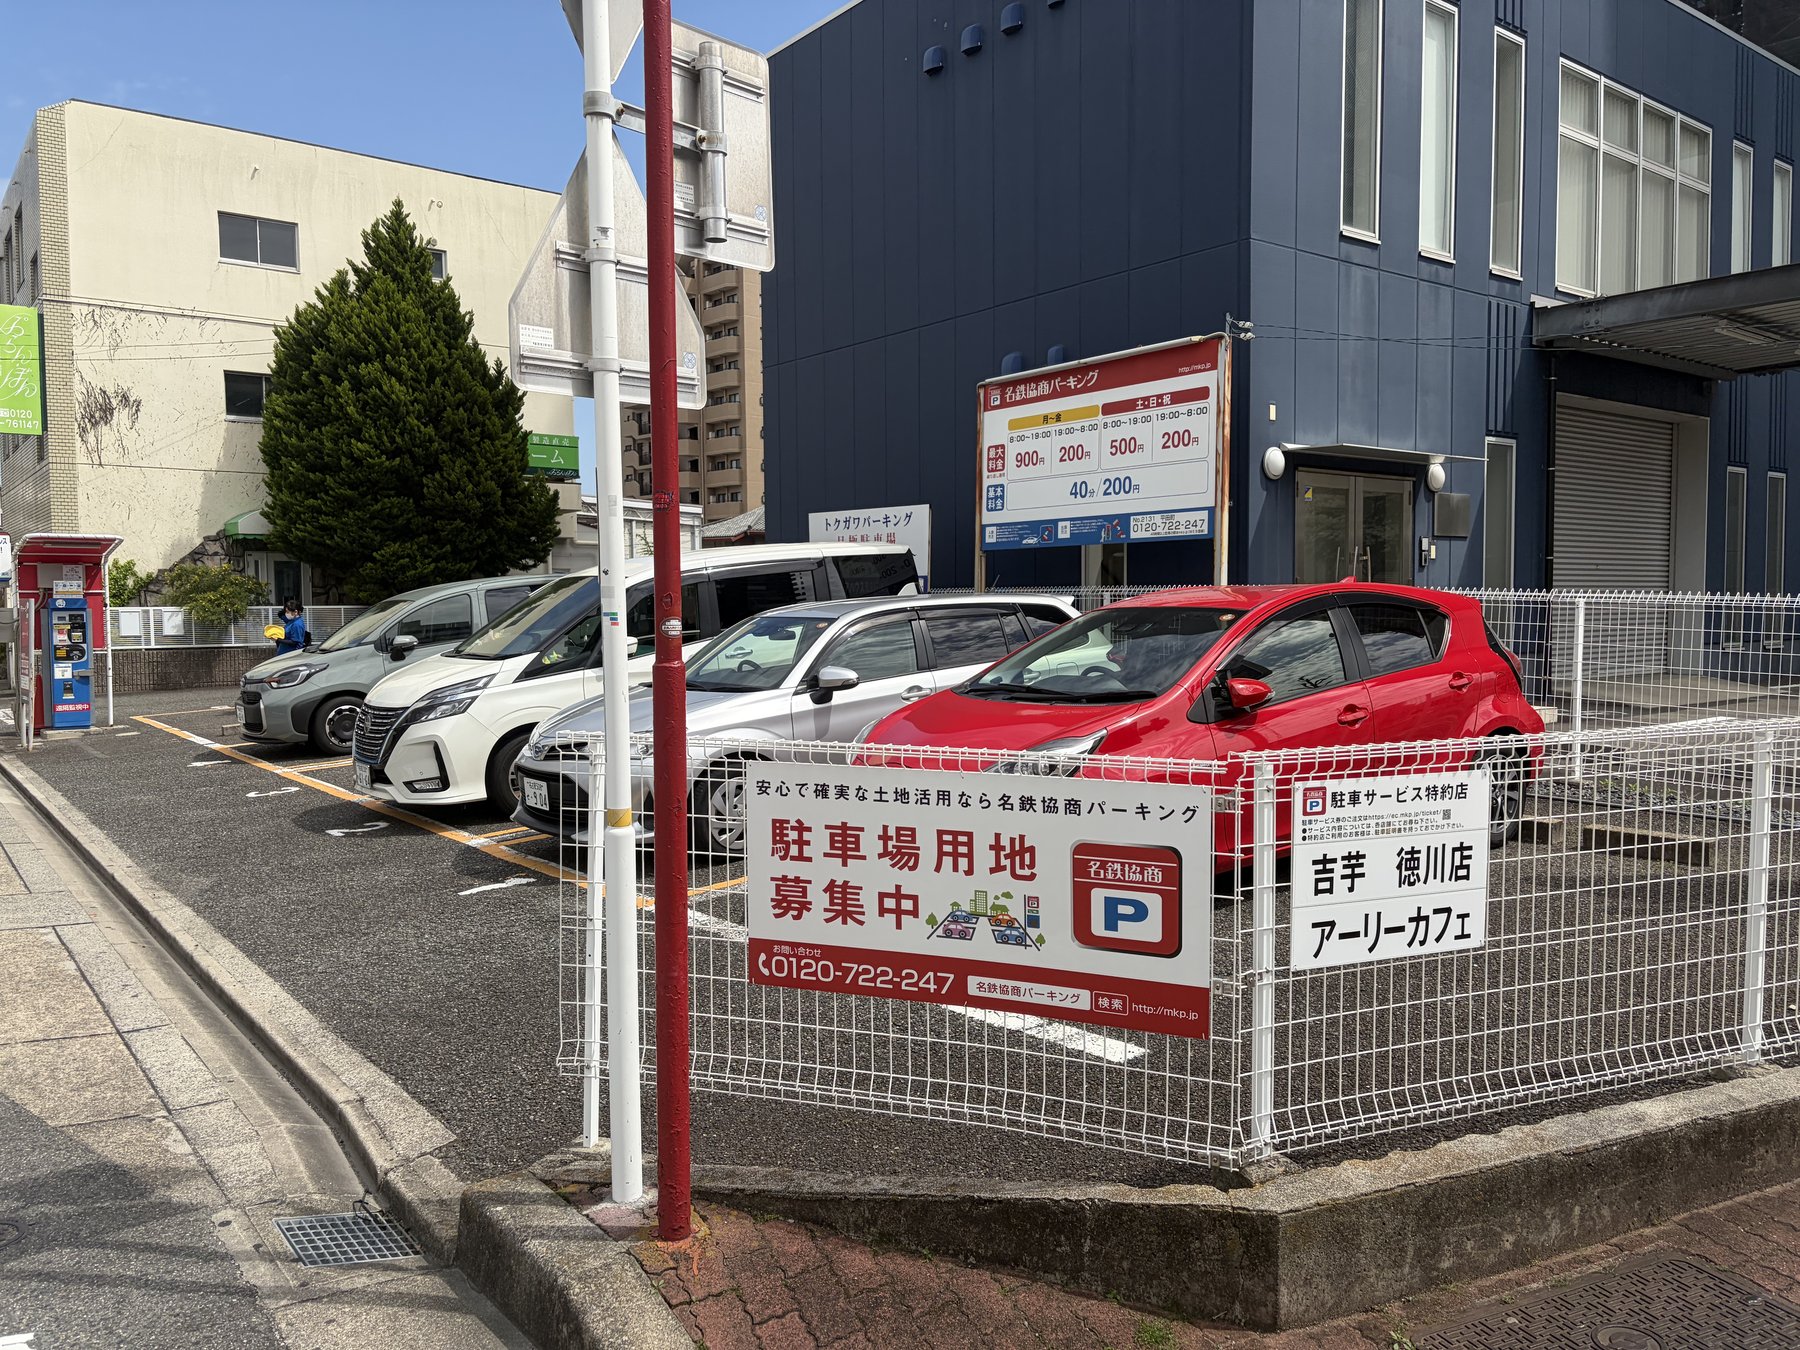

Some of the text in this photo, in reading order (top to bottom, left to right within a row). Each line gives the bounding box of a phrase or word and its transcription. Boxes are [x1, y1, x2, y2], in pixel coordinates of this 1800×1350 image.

[1005, 370, 1099, 402] 名鉄協商パーキング
[9, 410, 33, 418] 0120
[1109, 436, 1144, 457] 500円
[1161, 429, 1199, 450] 200円
[988, 446, 1004, 459] 最大
[1015, 450, 1045, 468] 900円
[1059, 444, 1091, 463] 200円
[988, 460, 1005, 471] 料金
[988, 487, 1003, 498] 基本
[988, 499, 1004, 511] 料金
[825, 511, 913, 531] トクガワパーキング
[1132, 519, 1206, 533] 0120-722-247
[756, 779, 1199, 824] 安心で確実な土地活用なら名鉄協商パーキング
[1330, 782, 1469, 809] 駐車サービス特約店
[770, 818, 1038, 882] 駐車場用地
[1087, 860, 1163, 884] 名鉄協商
[1312, 842, 1473, 896] 吉芋 徳川店
[770, 874, 920, 930] 募集中
[1104, 896, 1149, 933] P
[1311, 906, 1472, 959] アーリーカフェ
[772, 945, 822, 957] お問い合わせ
[771, 956, 955, 995] 0120-722-247
[976, 981, 1199, 1020] 名鉄協商パーキング 検索 http://mkp.jp
